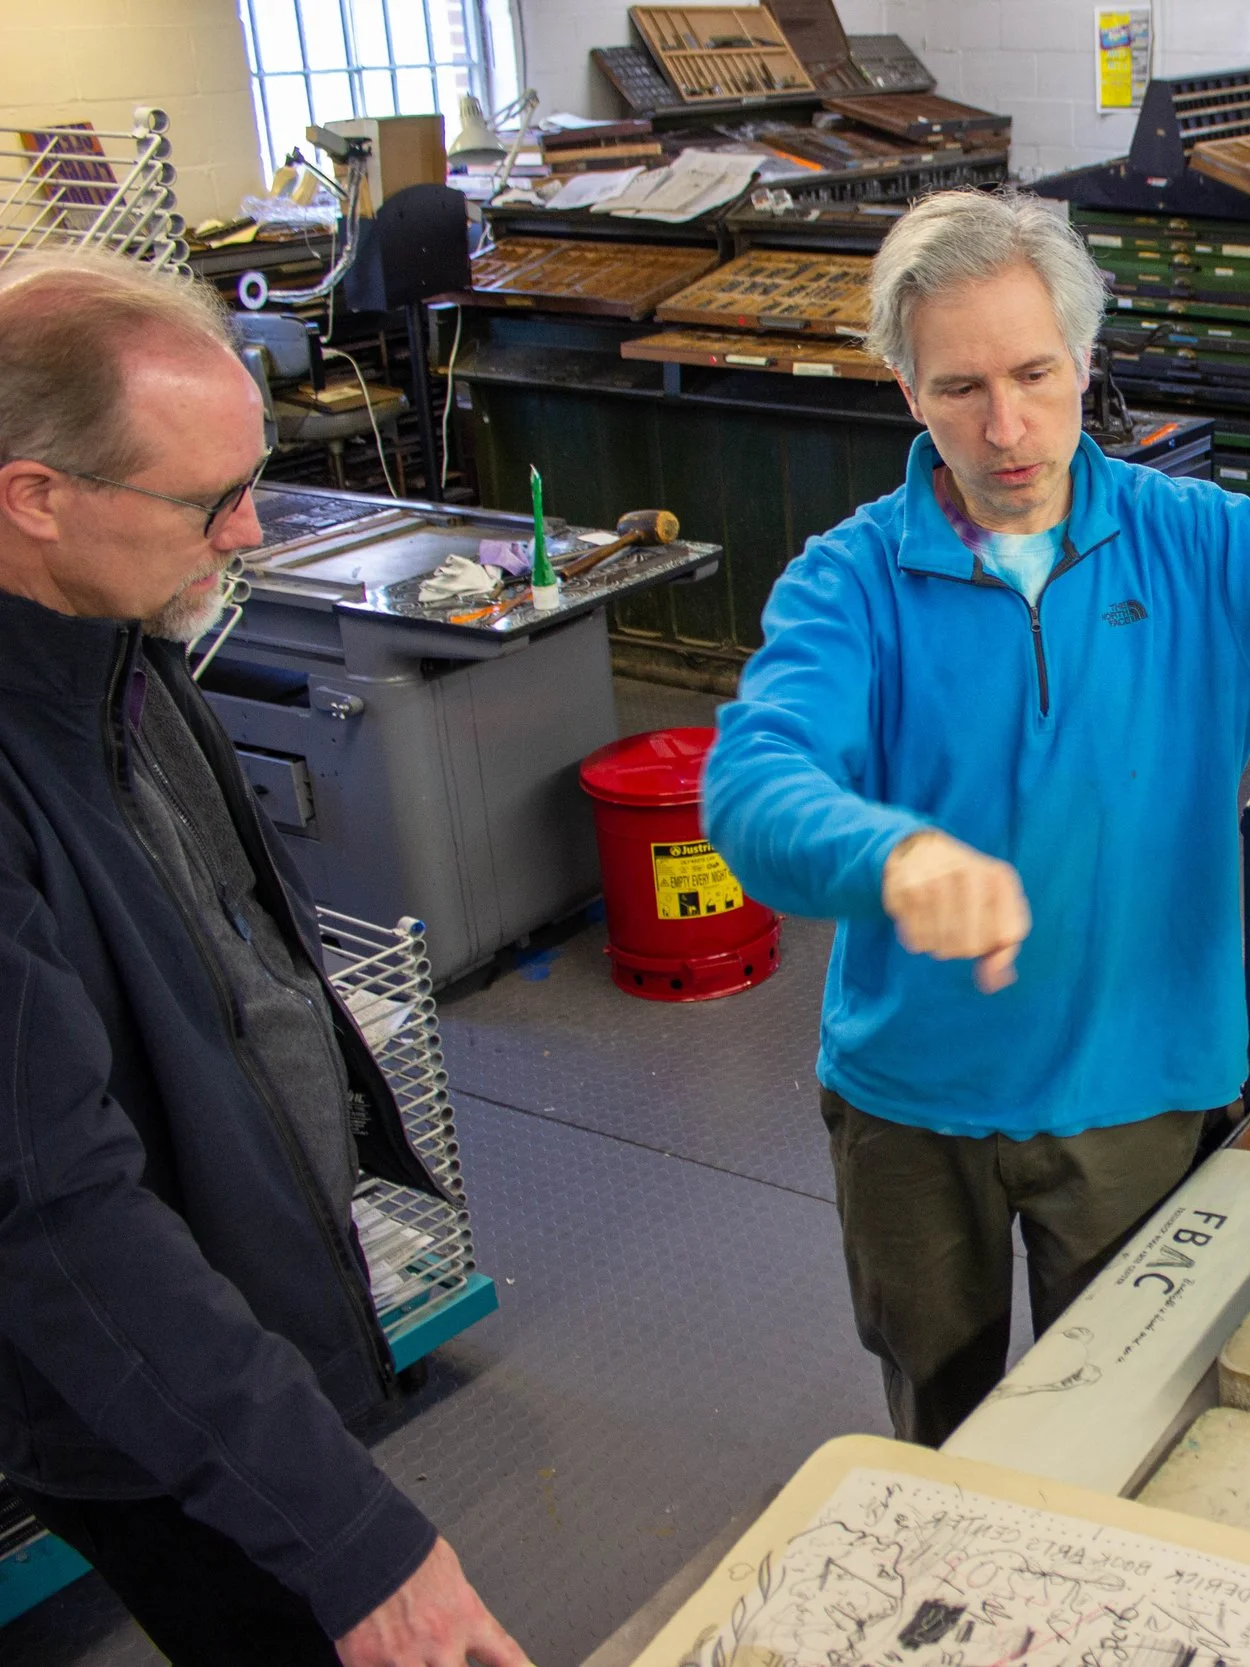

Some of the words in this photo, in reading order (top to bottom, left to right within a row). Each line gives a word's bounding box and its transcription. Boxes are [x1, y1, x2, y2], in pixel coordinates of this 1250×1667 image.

[682, 843, 714, 855] Justri
[670, 875, 690, 889] EMPTY
[691, 872, 709, 887] EVERY
